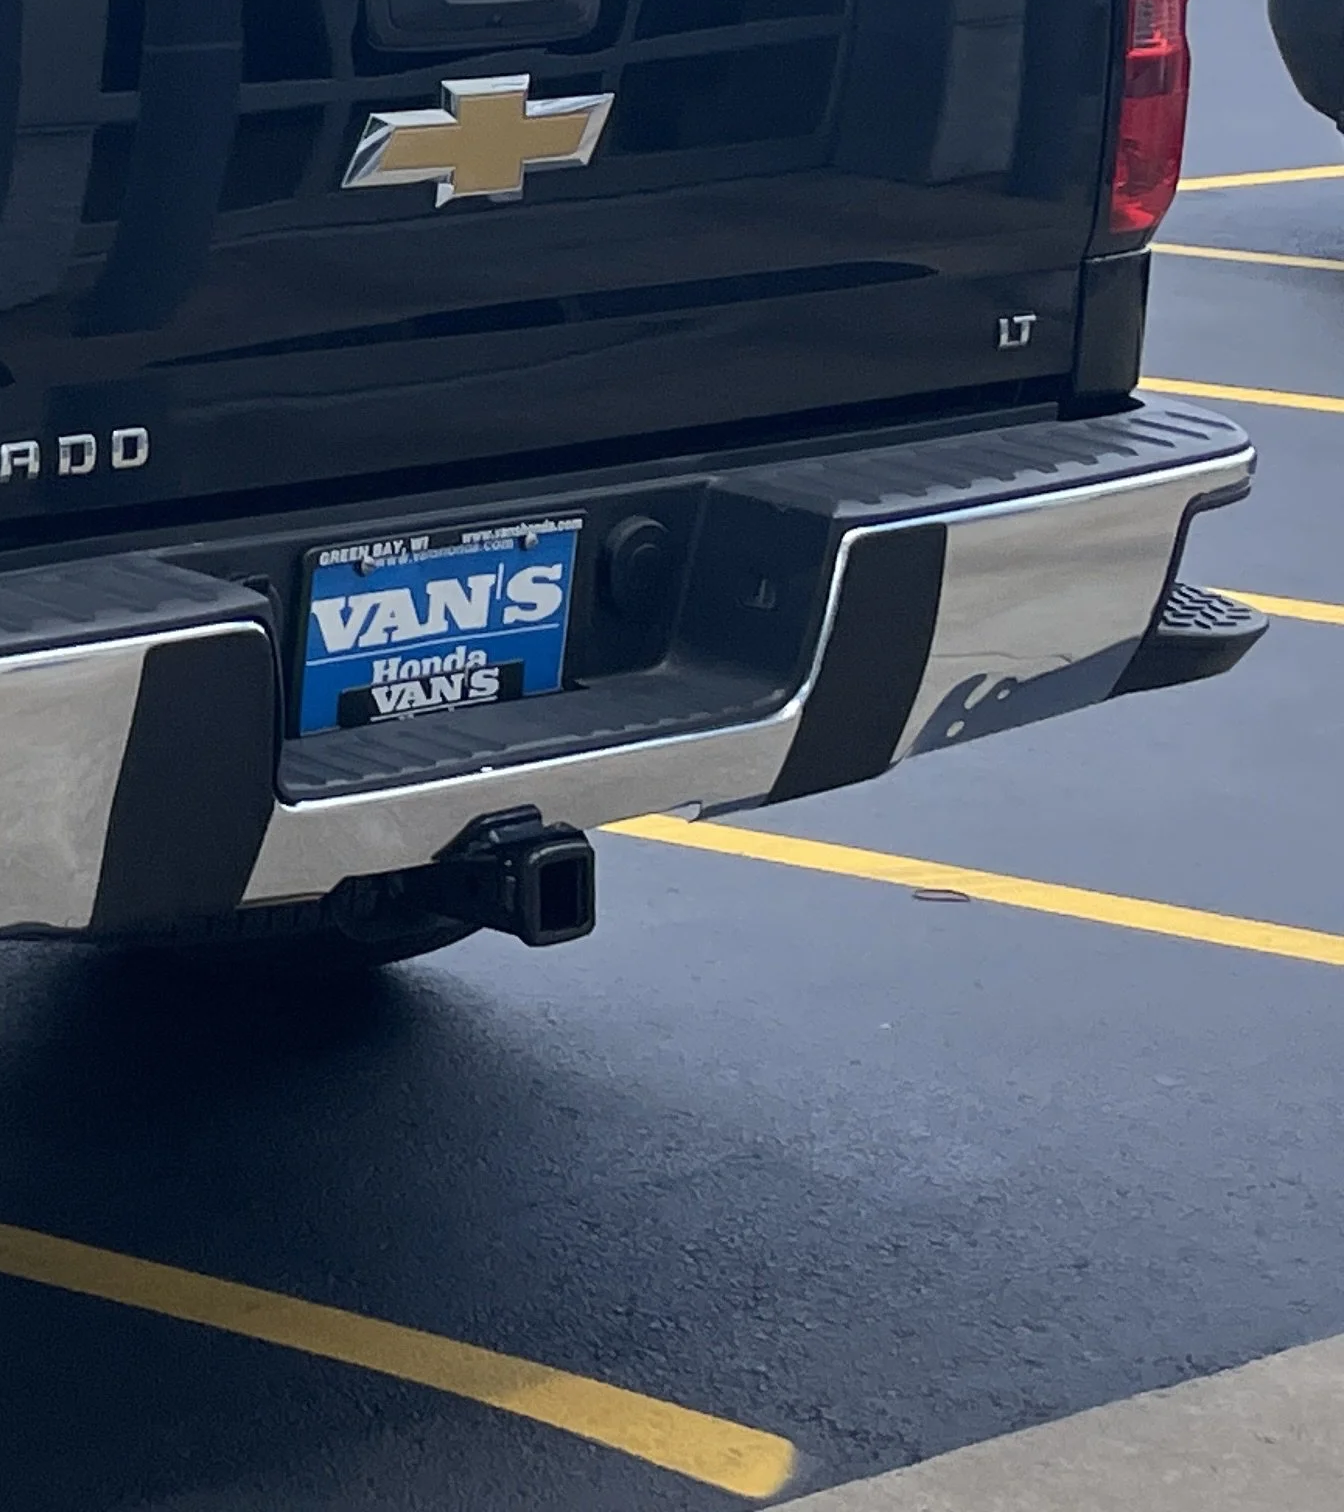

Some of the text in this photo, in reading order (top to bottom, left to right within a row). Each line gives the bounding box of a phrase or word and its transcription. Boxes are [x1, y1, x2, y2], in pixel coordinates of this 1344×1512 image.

[998, 314, 1037, 348] LT
[319, 544, 370, 567] GREEN
[410, 536, 430, 551] WI
[312, 562, 563, 653] VAN'S
[372, 645, 487, 684] Honda
